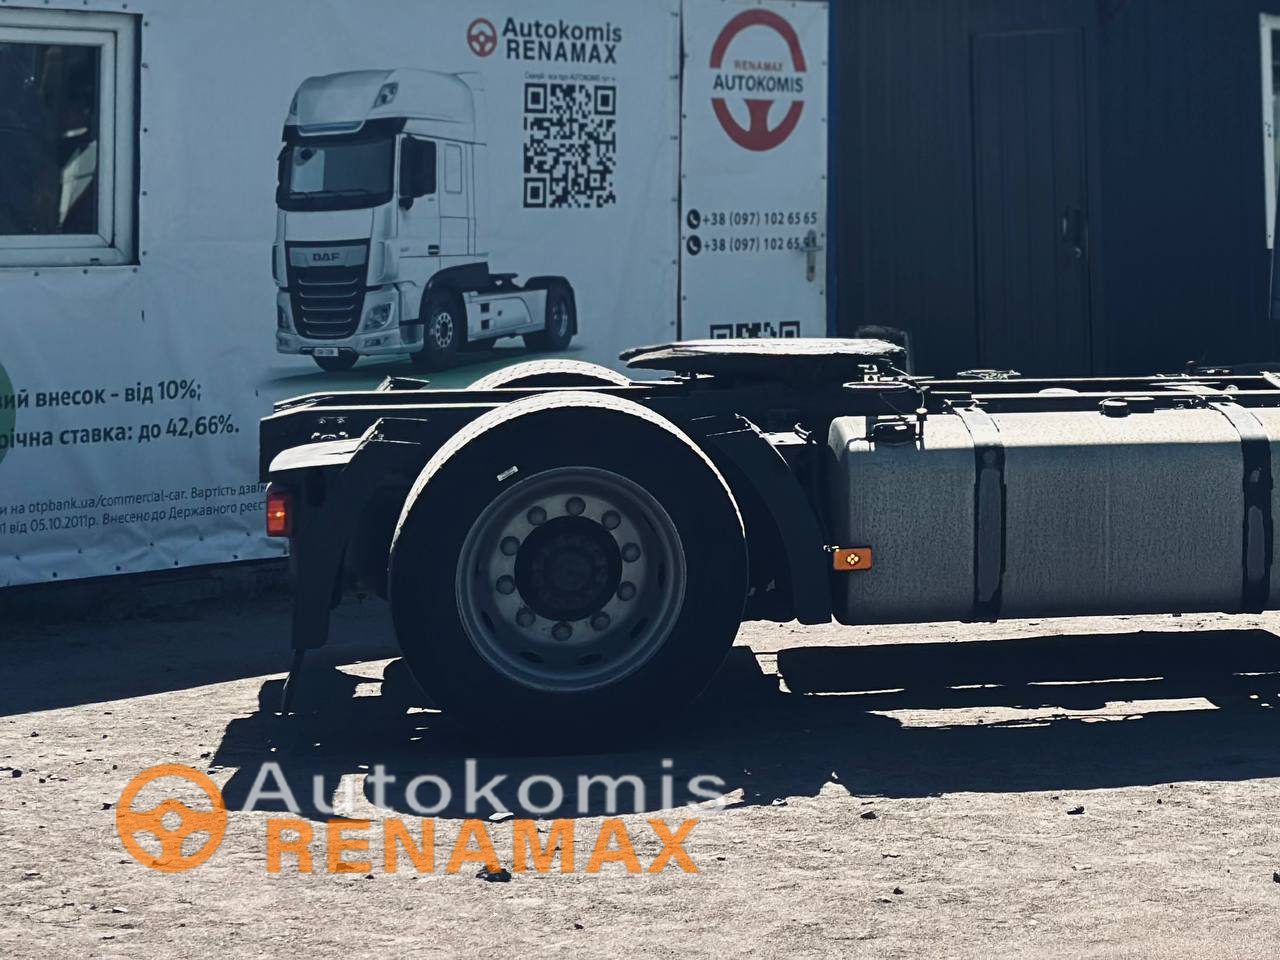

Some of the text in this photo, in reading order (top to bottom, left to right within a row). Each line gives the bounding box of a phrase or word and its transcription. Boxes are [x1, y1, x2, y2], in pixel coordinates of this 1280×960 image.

[502, 17, 622, 43] Autokomis
[506, 38, 617, 64] RENAMAX
[734, 59, 783, 72] RENAMAX
[713, 73, 804, 93] AUTOKOMIS
[703, 211, 817, 227] +38 (097) 102 65 65
[704, 238, 726, 251] +38
[729, 238, 760, 252] (097)
[764, 238, 783, 250] 102
[786, 237, 801, 250] 65
[313, 253, 340, 261] DAF
[0, 389, 29, 409] ий
[36, 389, 106, 408] внесок
[124, 381, 154, 405] від
[158, 378, 201, 401] 10%;
[59, 425, 133, 445] ставка:
[138, 424, 161, 443] до
[165, 414, 240, 439] 42,66%.
[191, 486, 236, 500] Вартість
